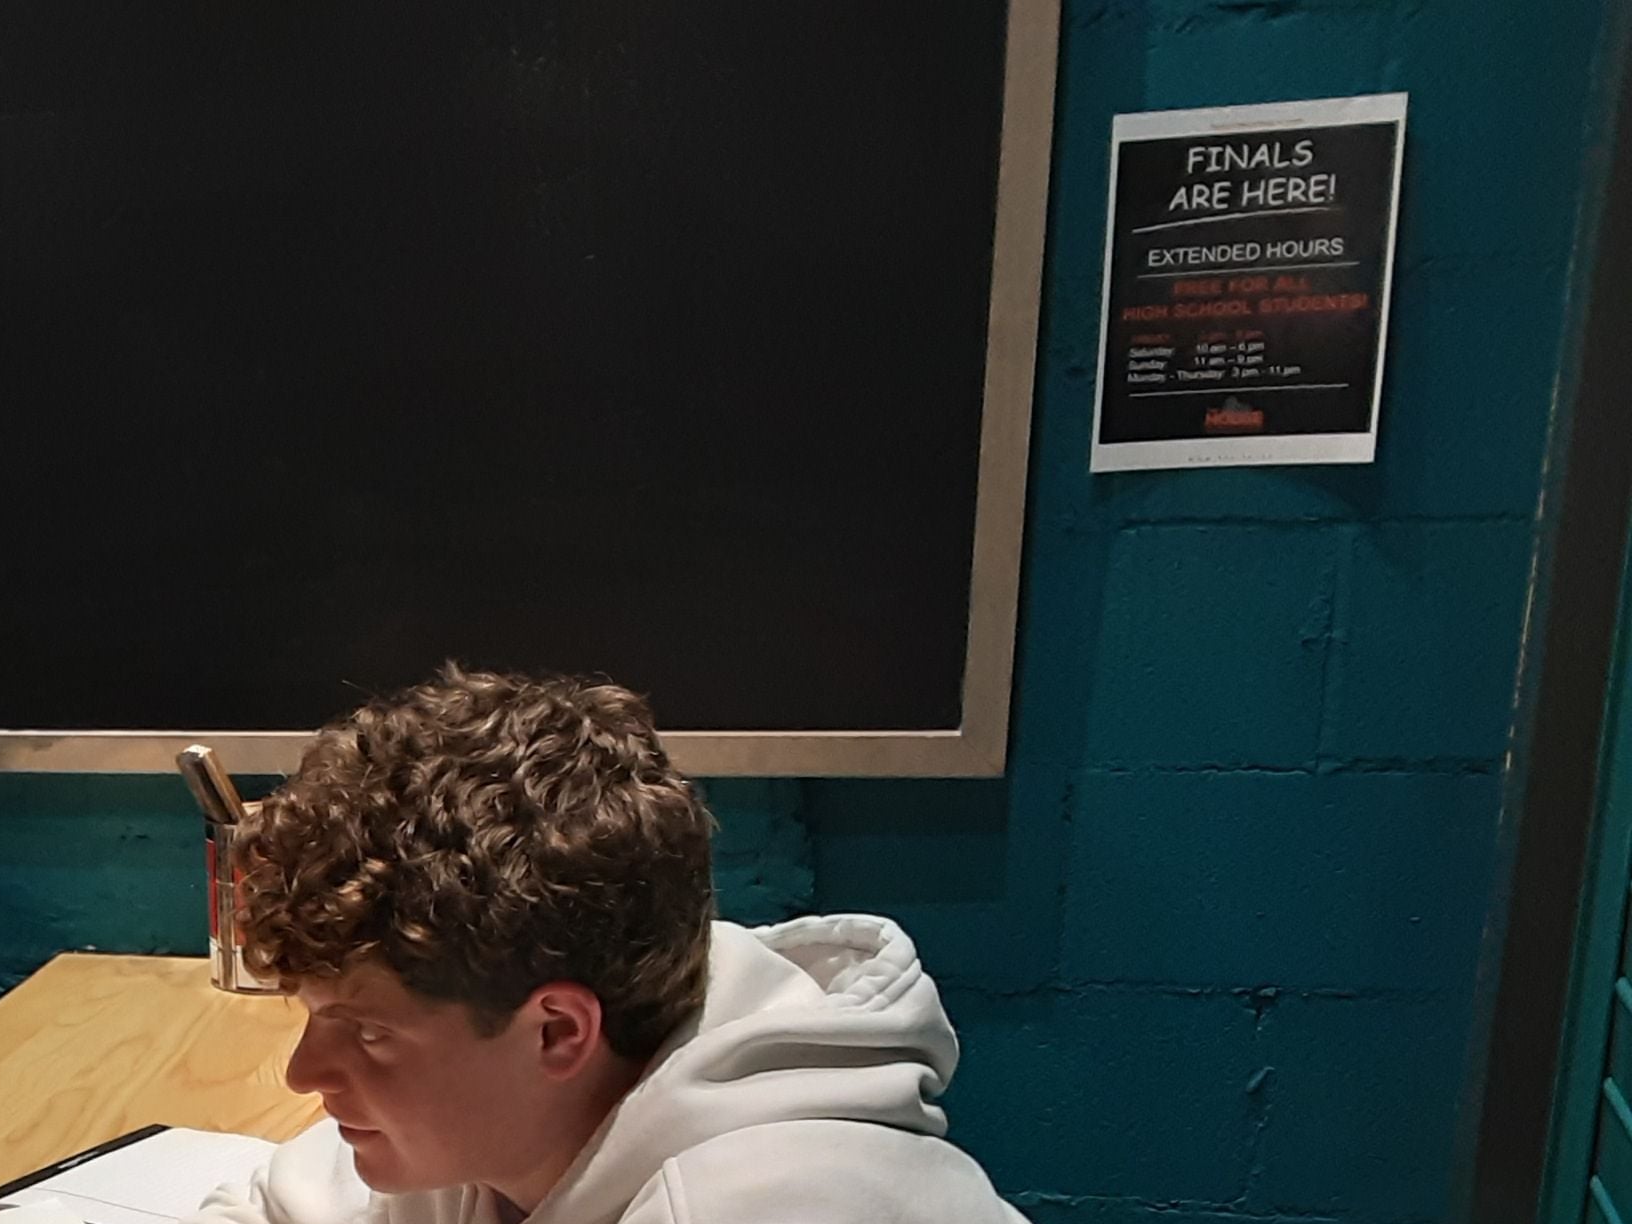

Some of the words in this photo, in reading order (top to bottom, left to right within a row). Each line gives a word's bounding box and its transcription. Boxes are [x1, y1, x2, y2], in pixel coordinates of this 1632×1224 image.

[1187, 139, 1315, 174] FINALS
[1168, 181, 1232, 211] ARE
[1241, 174, 1337, 207] HERE!
[1148, 243, 1261, 267] EXTENDED
[1266, 238, 1344, 260] HOURS
[1173, 280, 1221, 295] FREE
[1229, 278, 1268, 293] FOR
[1272, 276, 1310, 291] ALL
[1123, 304, 1168, 320] HIGH
[1174, 301, 1251, 317] SCHOOL
